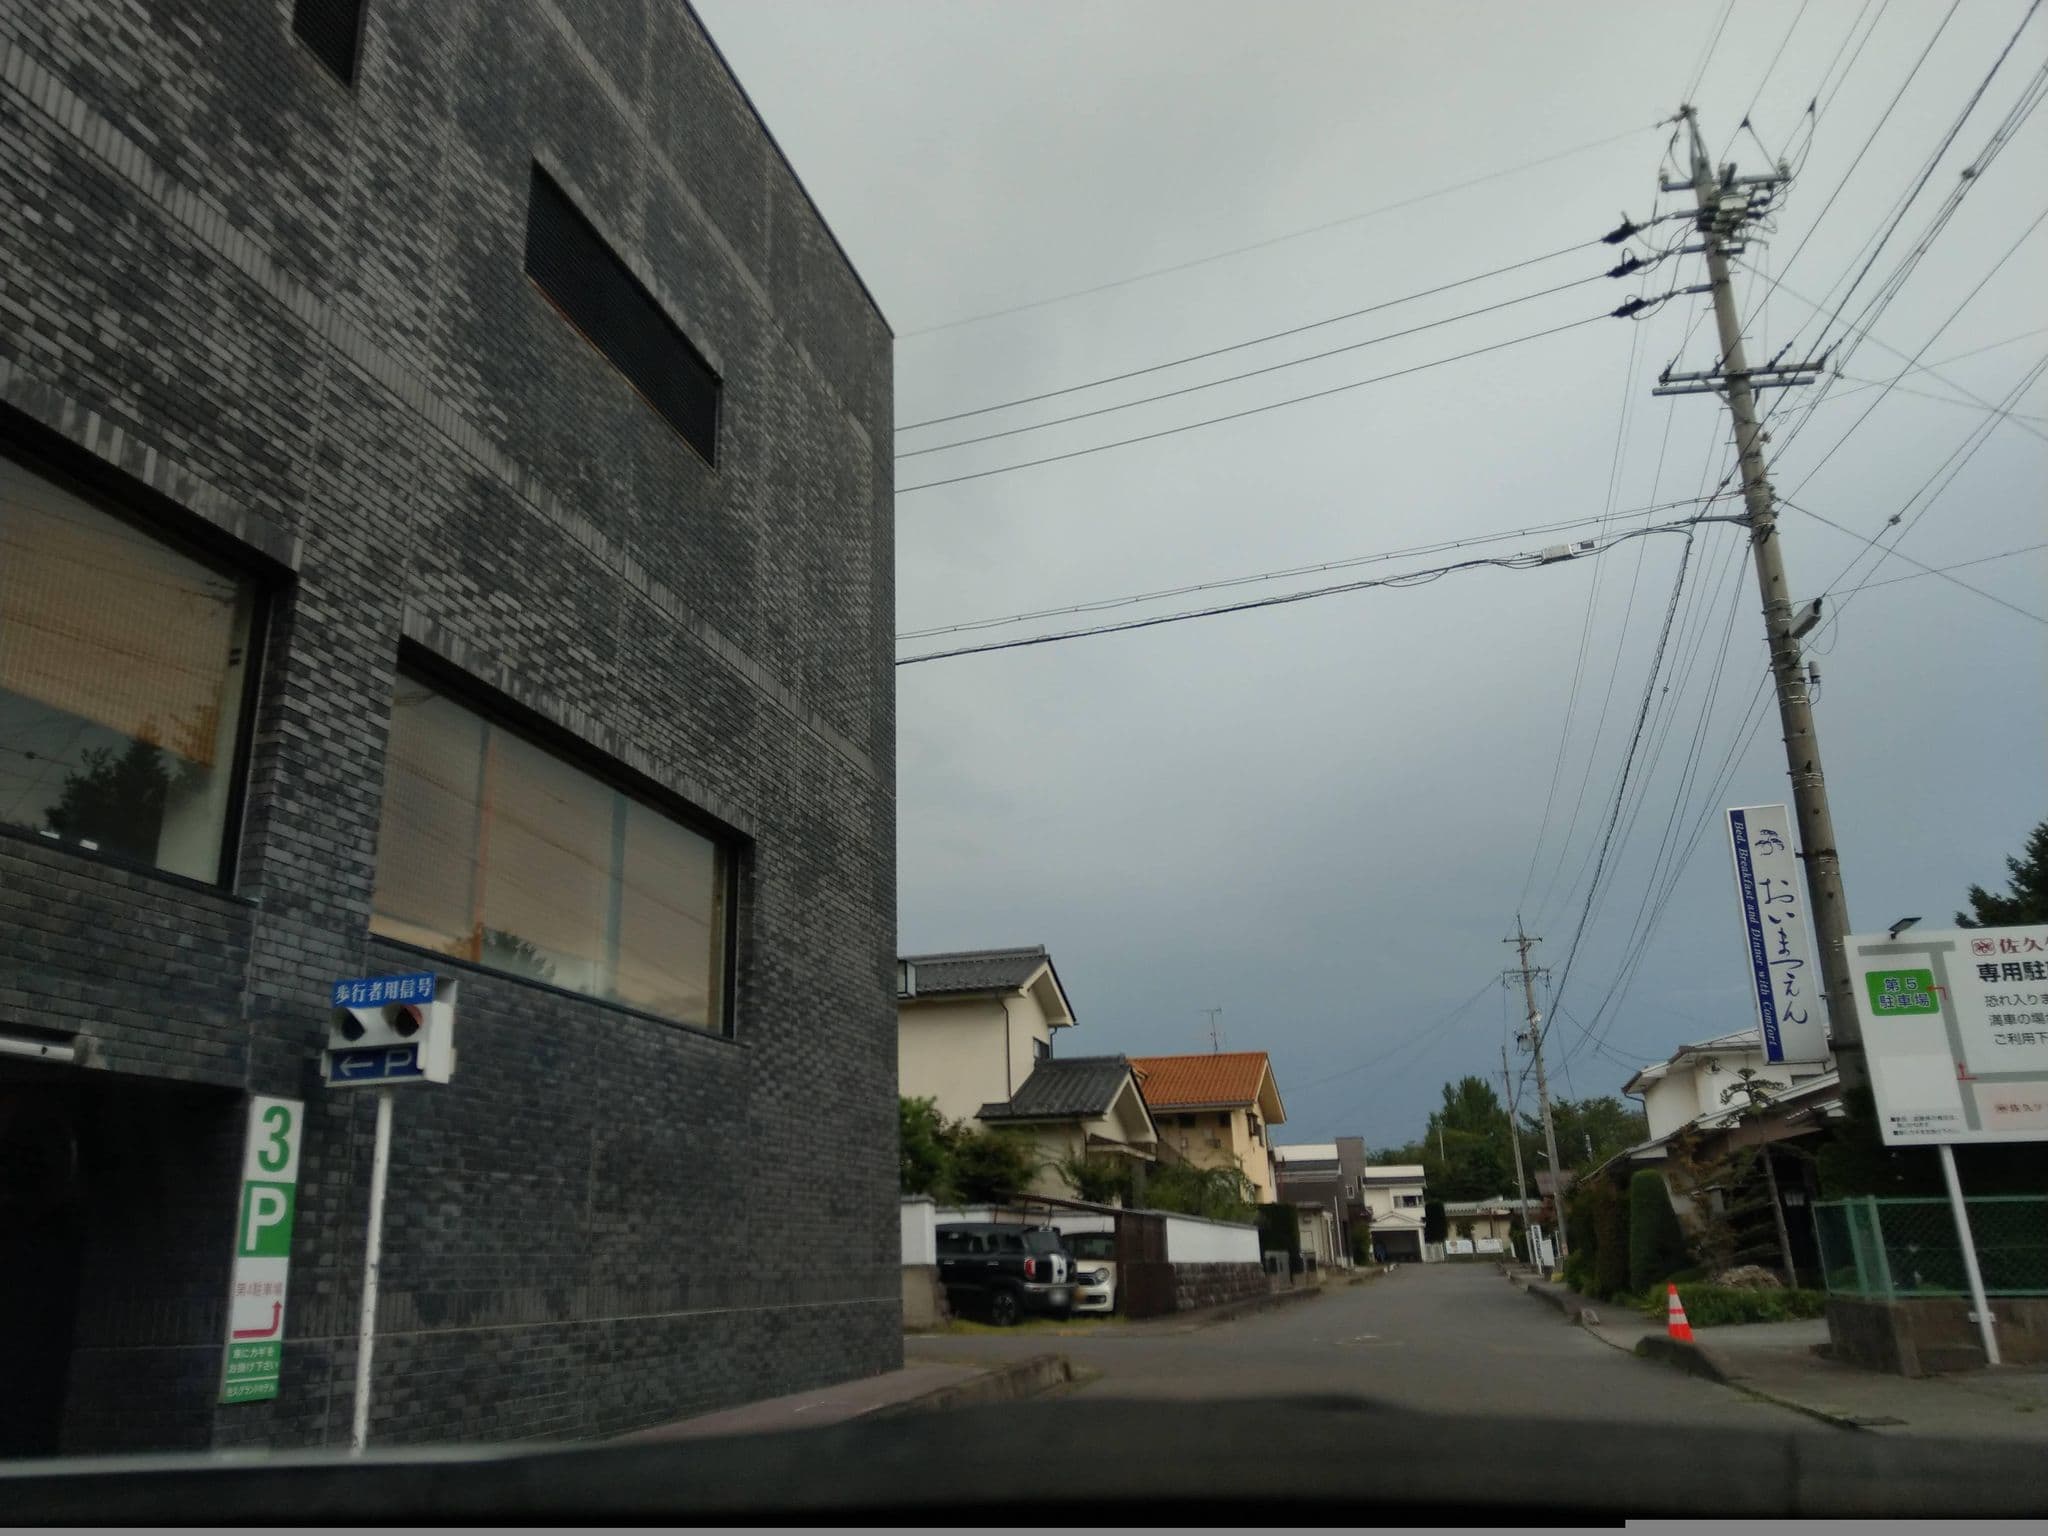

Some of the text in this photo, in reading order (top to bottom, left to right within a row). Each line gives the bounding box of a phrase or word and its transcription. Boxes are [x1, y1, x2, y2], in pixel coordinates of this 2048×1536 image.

[1738, 849, 1754, 901] Breakfast
[1747, 903, 1758, 924] and
[1751, 927, 1763, 966] Dinner
[1759, 878, 1809, 1025] おいまつえん
[2000, 937, 2048, 954] 佐久
[1758, 970, 1769, 996] with
[1976, 960, 2048, 983] 専用駐
[336, 977, 433, 1005] 歩行者用信号
[1879, 993, 1931, 1009] 駐車場
[1762, 1001, 1778, 1046] Comfort
[1989, 1012, 2048, 1026] 満車の場
[384, 1048, 412, 1077] P
[257, 1105, 292, 1173] 3
[245, 1187, 288, 1252] P
